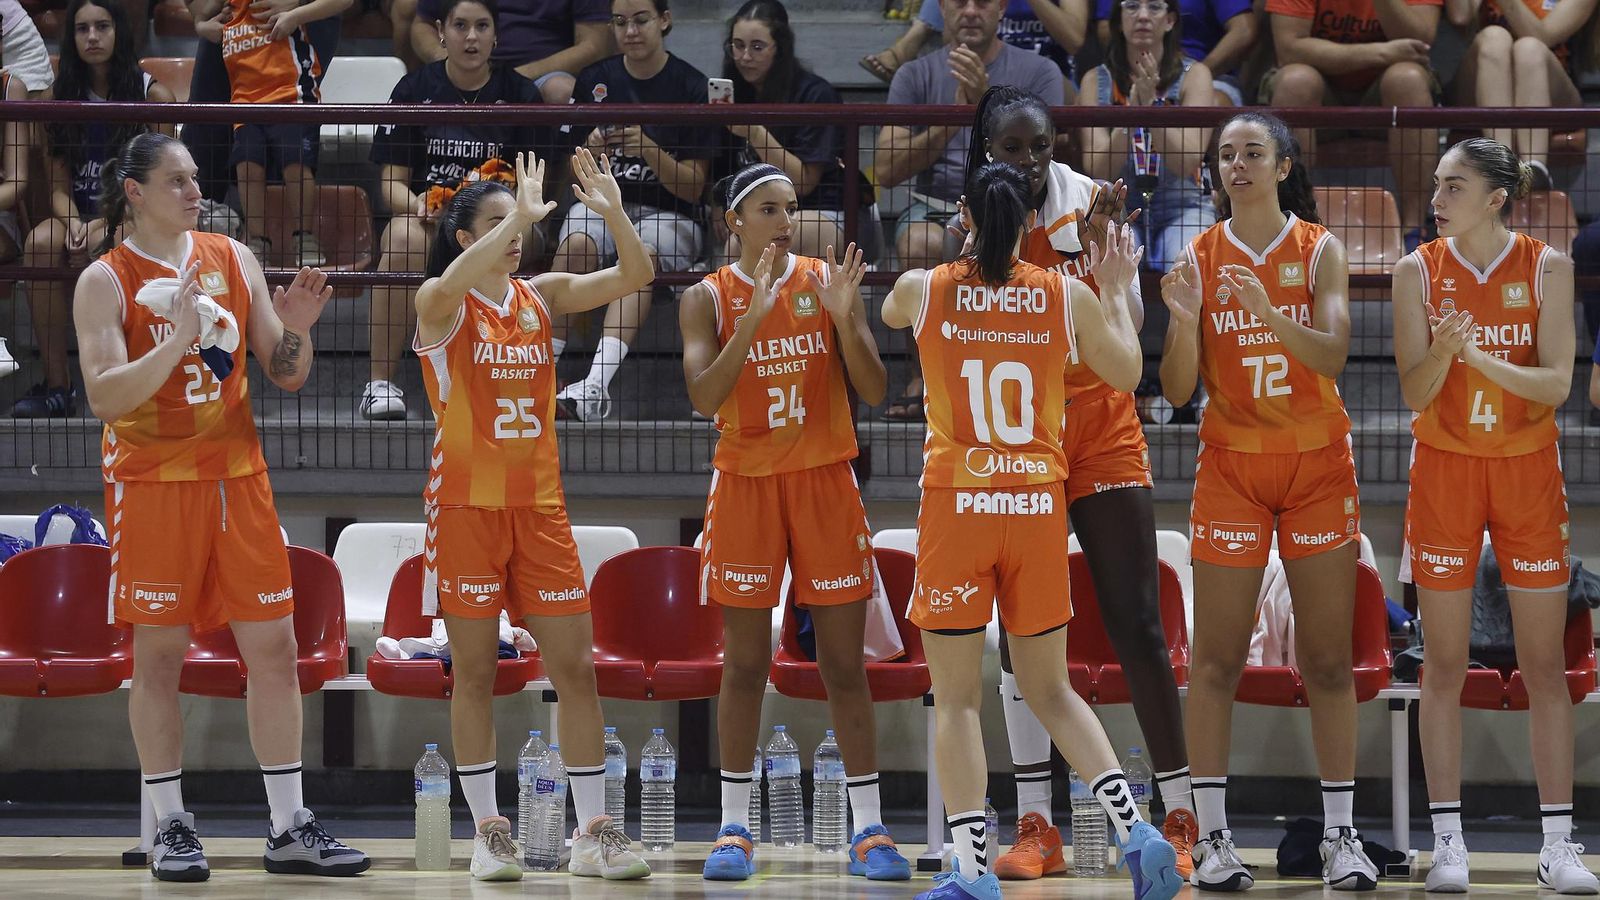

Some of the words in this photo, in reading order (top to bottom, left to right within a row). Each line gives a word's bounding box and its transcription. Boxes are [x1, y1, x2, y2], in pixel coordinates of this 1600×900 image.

[425, 138, 483, 159] VALENCIA
[956, 285, 1048, 314] ROMERO
[1211, 303, 1312, 335] VALEIA
[1238, 331, 1280, 347] BASK
[1471, 323, 1533, 346] ENCIA
[473, 342, 550, 365] VALENCIA
[745, 331, 828, 364] ALENCIA
[491, 367, 537, 380] BASKET
[757, 359, 808, 378] BASKET
[1242, 354, 1292, 399] 72
[767, 384, 806, 429] 24
[960, 359, 1034, 445] 10
[1470, 390, 1497, 432] 4
[494, 398, 542, 439] 25
[968, 450, 1048, 476] Midea
[956, 492, 1053, 515] PAMESA
[1213, 529, 1257, 542] PULEVA
[1422, 552, 1464, 566] PULEVA
[1512, 558, 1560, 573] Vitaldin
[725, 570, 767, 583] PULEVA
[811, 575, 861, 591] Vitaldin
[135, 589, 177, 601] PULEVA
[461, 583, 500, 594] PULEVA
[538, 587, 586, 602] Vitaldin
[930, 605, 953, 614] Seguros
